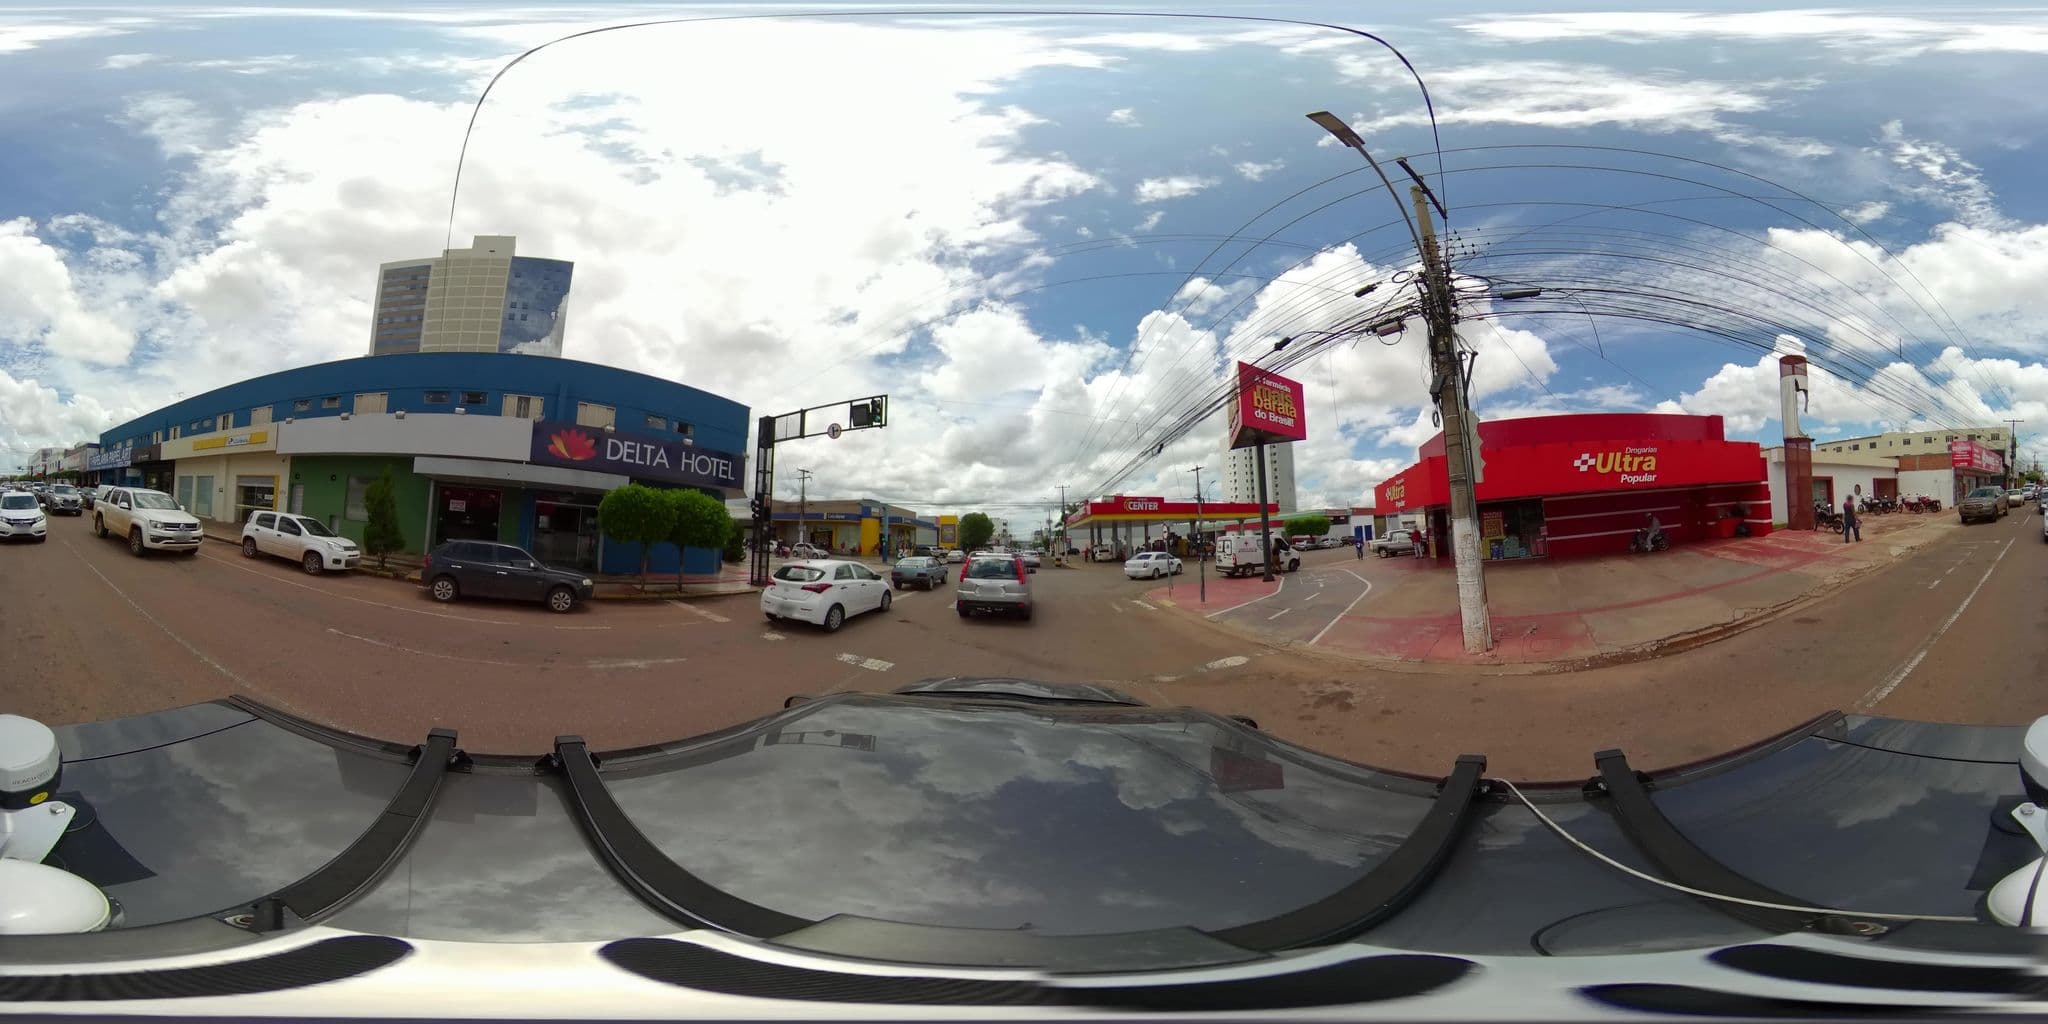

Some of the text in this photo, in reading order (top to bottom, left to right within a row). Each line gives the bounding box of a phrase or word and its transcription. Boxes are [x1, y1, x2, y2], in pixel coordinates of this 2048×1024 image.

[1255, 385, 1293, 405] mais
[1253, 391, 1296, 418] barata
[1255, 409, 1294, 427] do Brasil!
[606, 438, 736, 481] DELTA HOTEL
[1625, 446, 1657, 455] Drogarias
[1596, 452, 1656, 473] Ultra
[1620, 473, 1657, 484] Popular
[1390, 485, 1405, 502] Ultra
[1128, 501, 1159, 511] CENTER
